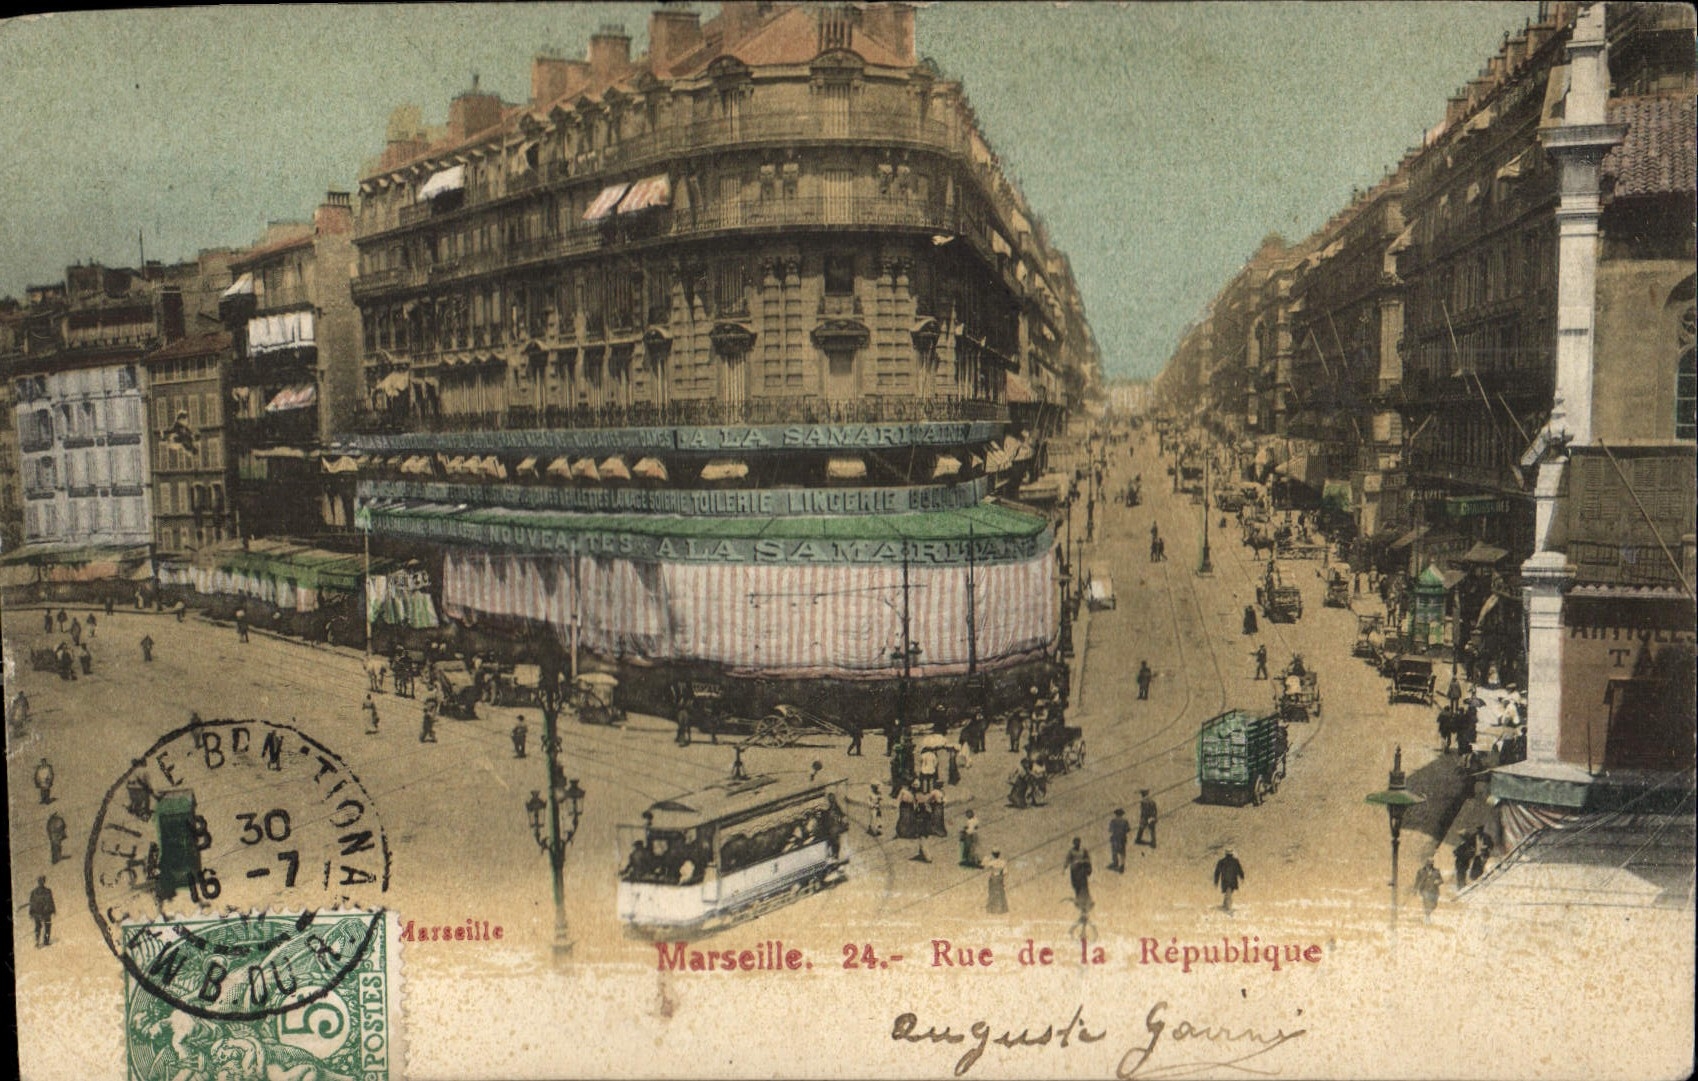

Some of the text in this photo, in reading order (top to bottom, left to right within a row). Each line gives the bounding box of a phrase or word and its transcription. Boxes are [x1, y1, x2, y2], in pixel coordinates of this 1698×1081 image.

[691, 430, 709, 449] A
[719, 429, 771, 449] LA
[692, 491, 772, 515] TOILERIE
[788, 490, 896, 515] LINGERIE
[655, 536, 680, 561] A
[685, 538, 745, 562] LA
[235, 808, 292, 845] 30
[281, 995, 345, 1040] 5
[362, 975, 385, 1067] POSTES
